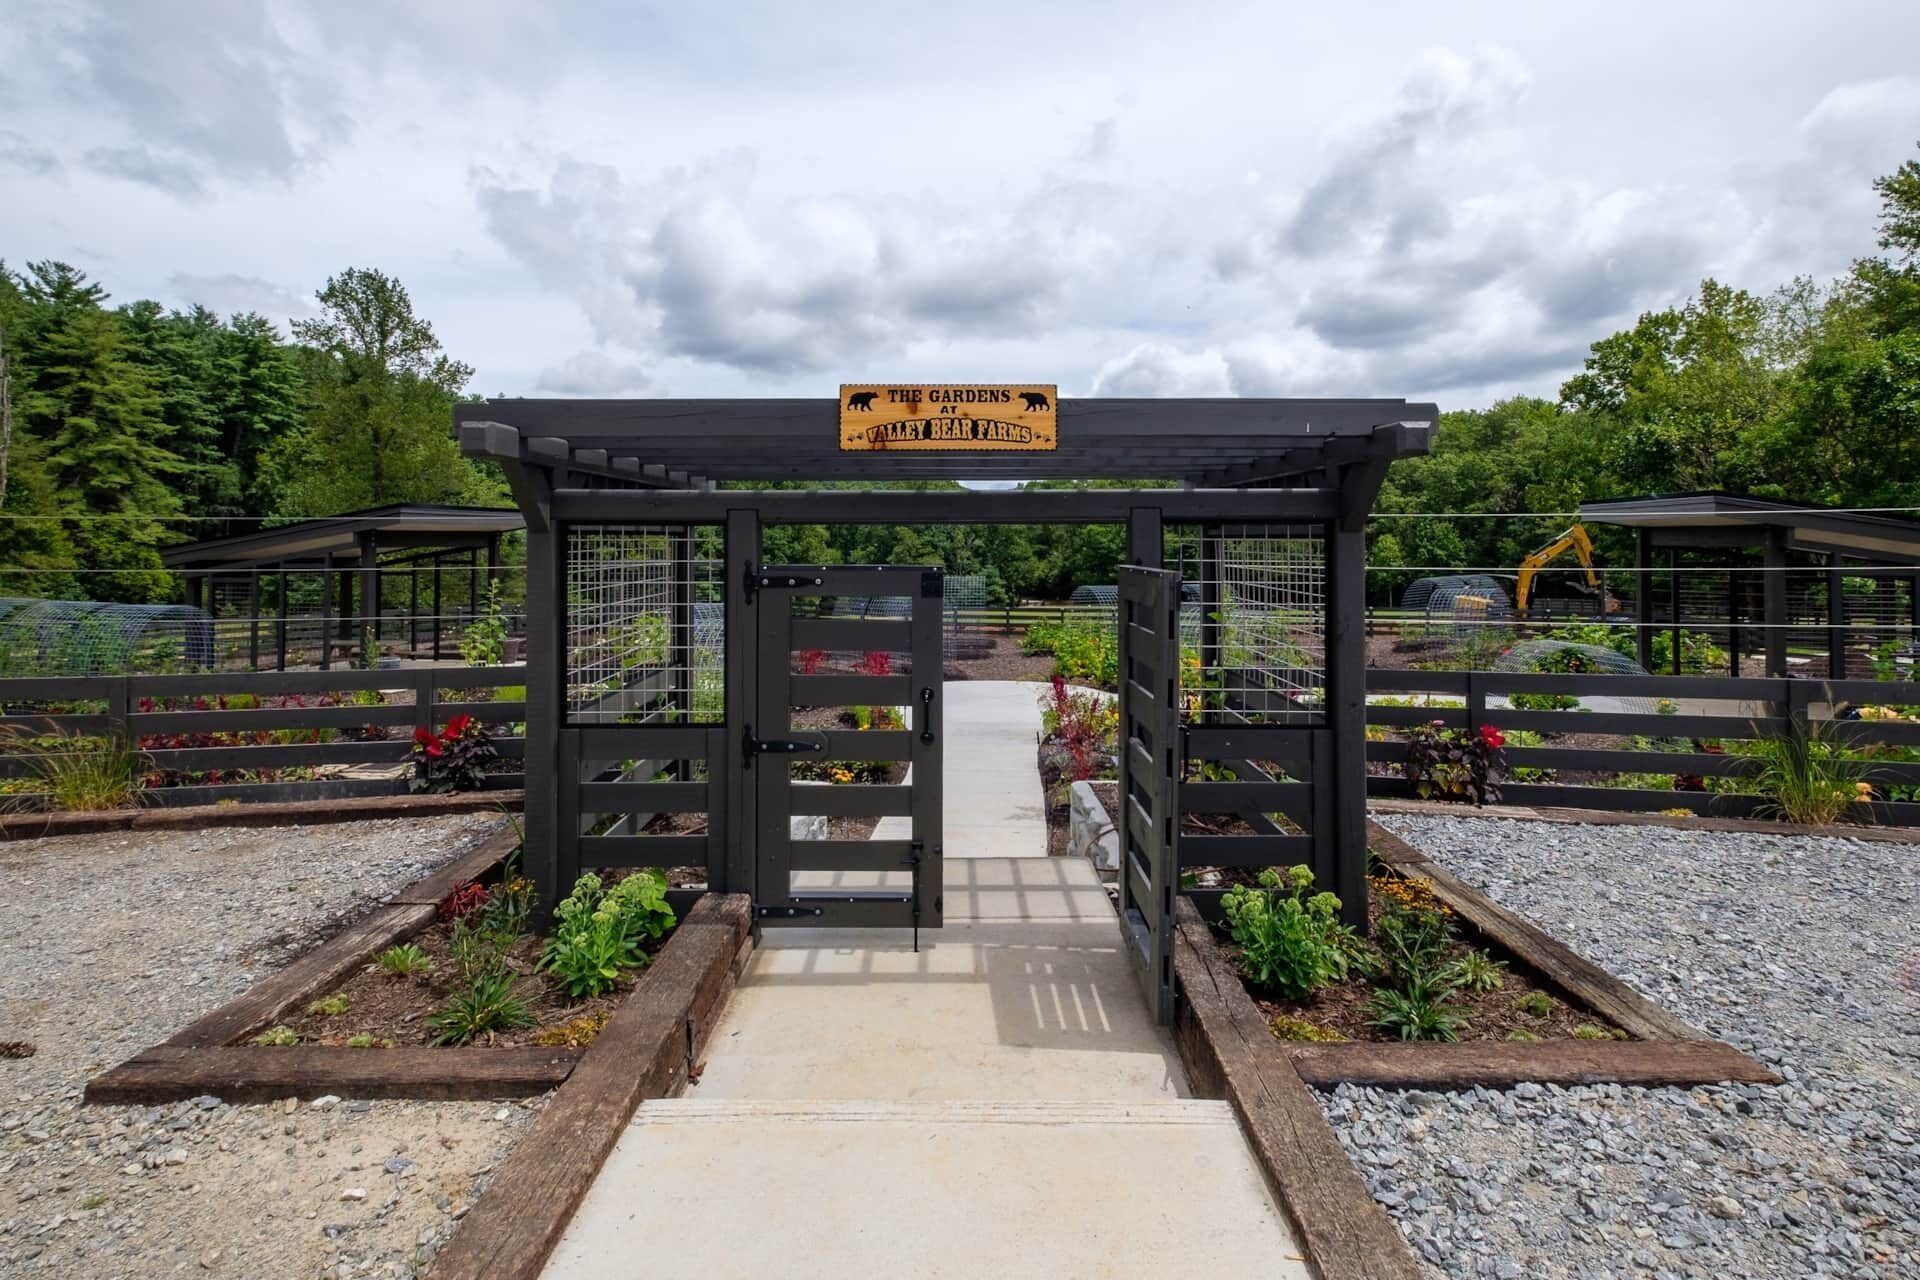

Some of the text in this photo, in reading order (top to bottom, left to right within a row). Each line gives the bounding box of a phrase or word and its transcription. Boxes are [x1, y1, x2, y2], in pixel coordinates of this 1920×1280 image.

[888, 389, 1011, 403] THE GARDENS
[940, 405, 958, 414] AT
[867, 418, 1032, 443] VALLEY BEAR FARMS
